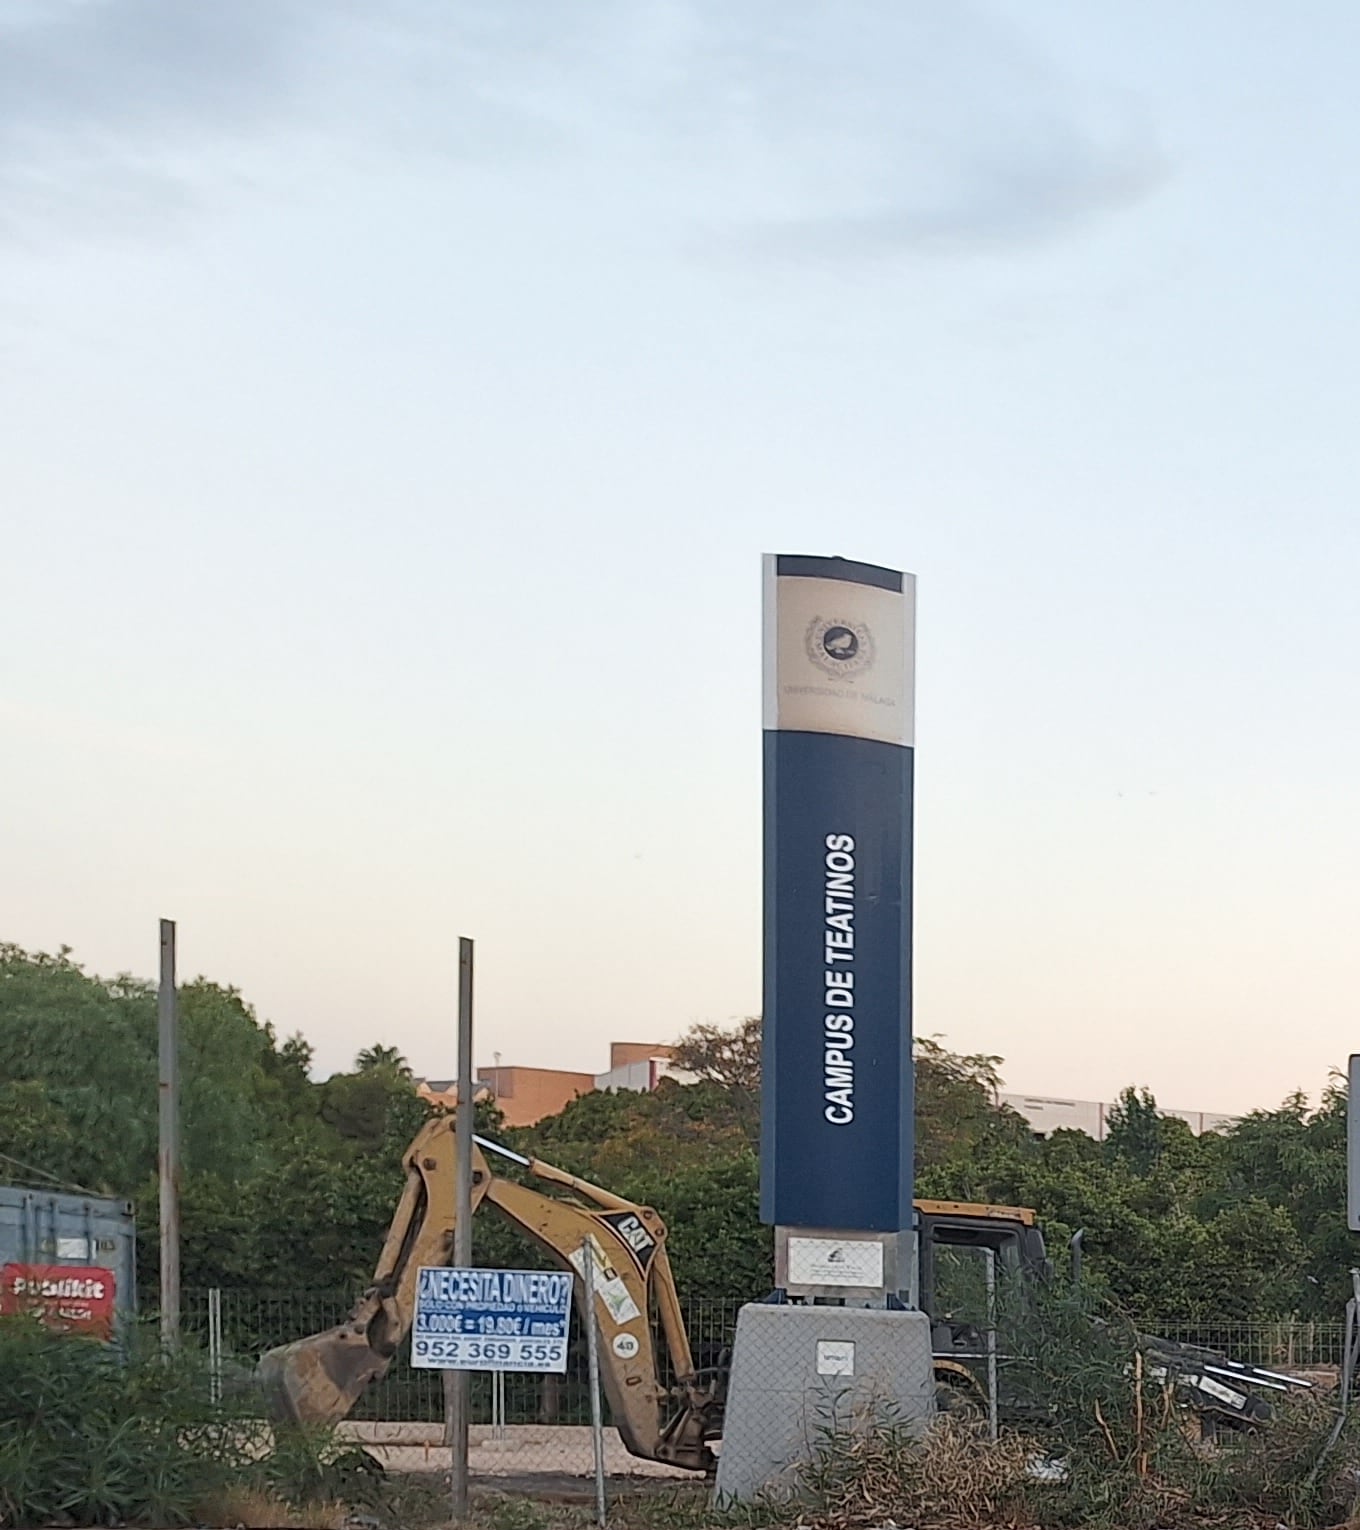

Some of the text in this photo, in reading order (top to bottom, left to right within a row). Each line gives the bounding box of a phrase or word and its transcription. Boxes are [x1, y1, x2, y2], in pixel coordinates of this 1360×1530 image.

[824, 833, 856, 1126] CAMPUS DE TEATINOS
[617, 1216, 656, 1253] CAT
[420, 1271, 569, 1304] ¿NECESITA DINERO?
[416, 1340, 562, 1361] 952 369 555
